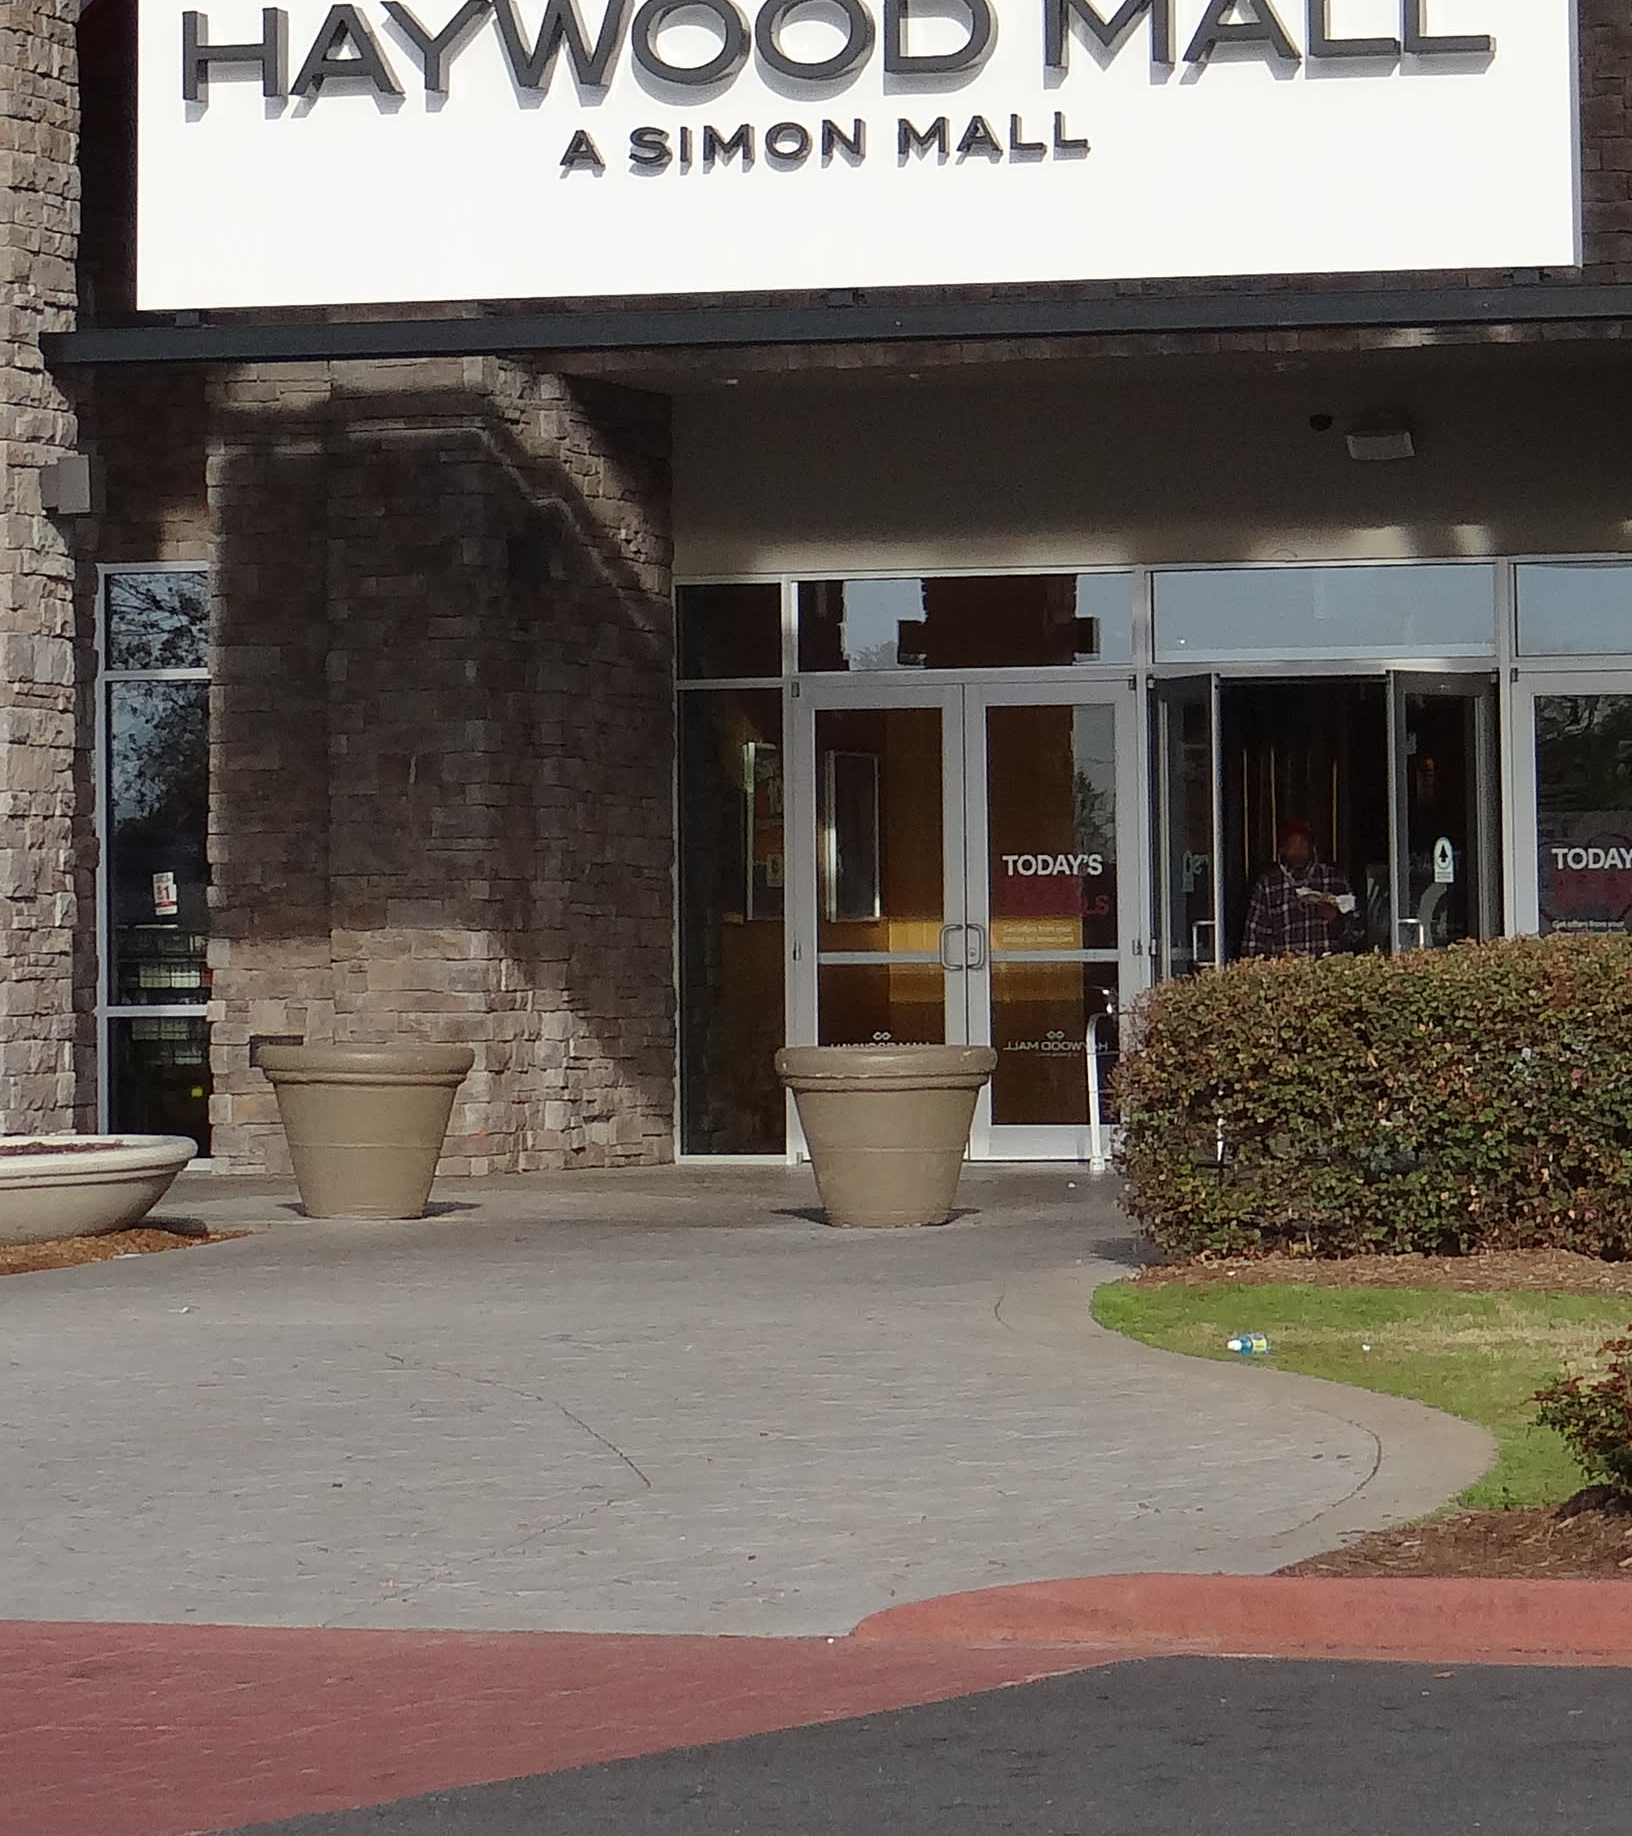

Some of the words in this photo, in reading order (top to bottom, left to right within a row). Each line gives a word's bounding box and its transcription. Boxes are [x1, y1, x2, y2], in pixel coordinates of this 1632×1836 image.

[560, 130, 604, 169] A
[628, 116, 866, 167] SIMON
[898, 111, 1091, 158] MALL
[1002, 854, 1104, 876] TODAY'S
